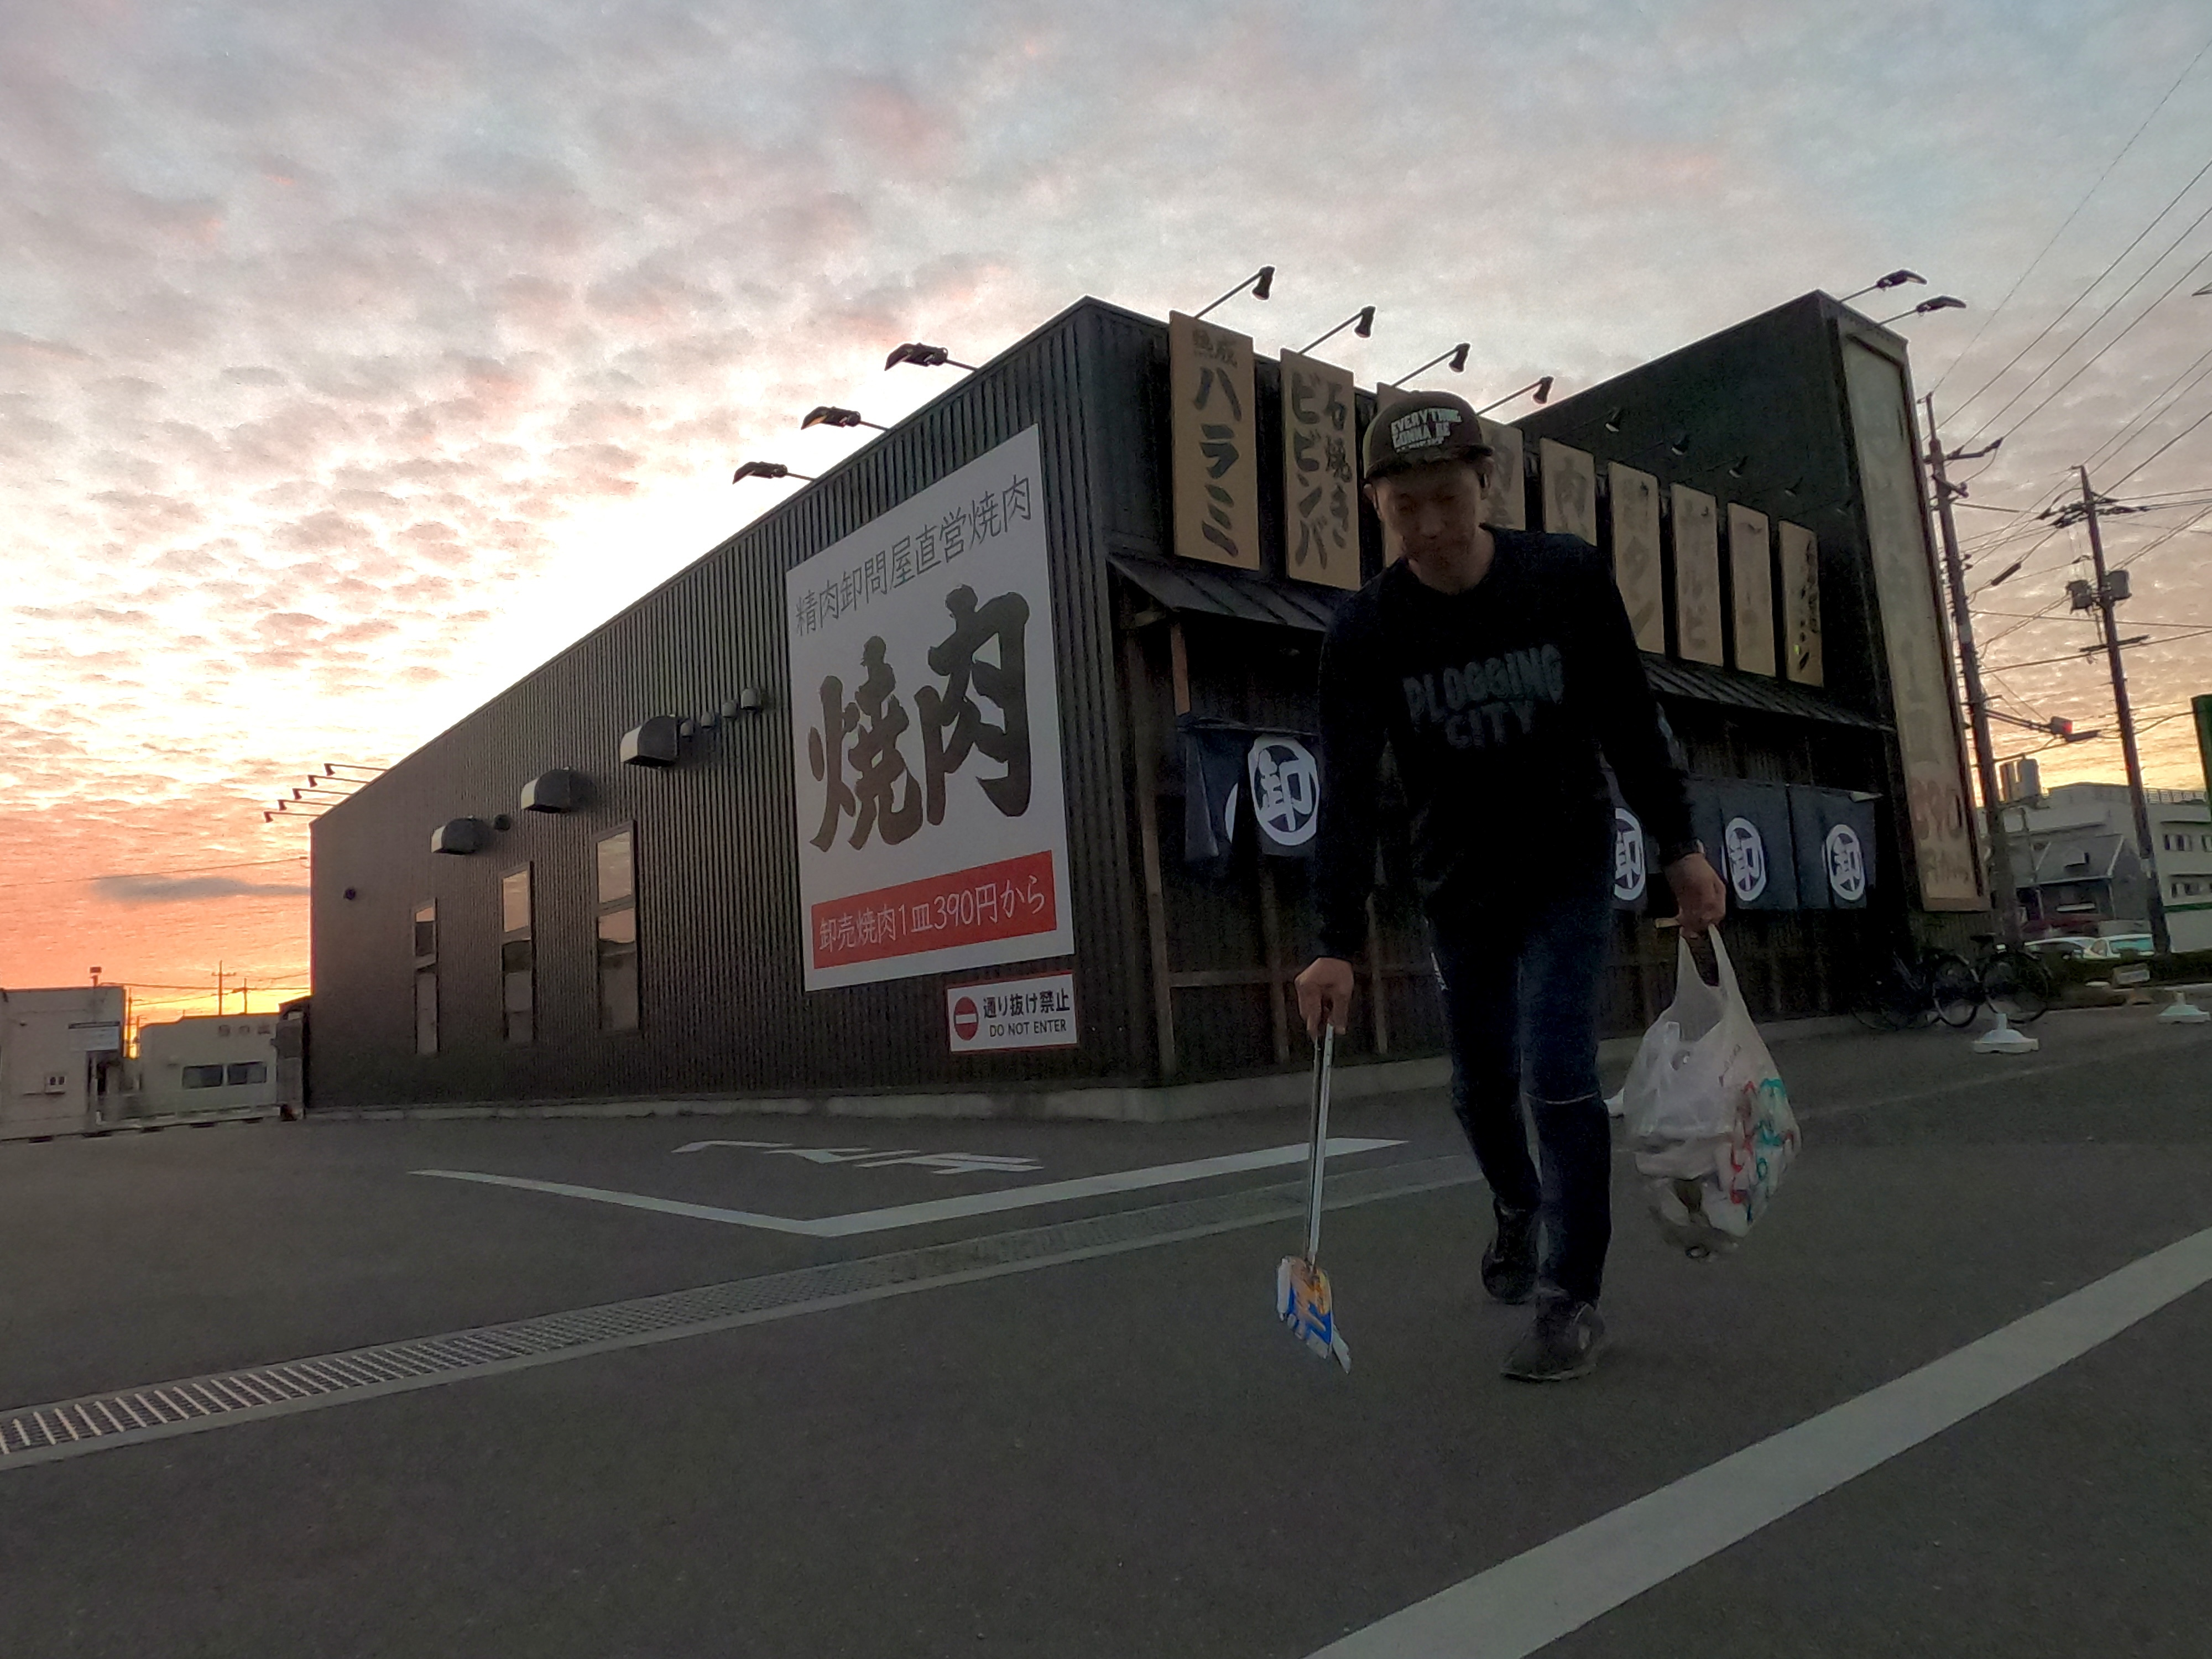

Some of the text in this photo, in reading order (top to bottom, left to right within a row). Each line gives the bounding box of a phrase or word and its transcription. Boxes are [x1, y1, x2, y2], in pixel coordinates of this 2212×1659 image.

[1193, 367, 1242, 559] ハラミ
[1292, 371, 1328, 570] ビビンバ
[795, 474, 1032, 637] 精肉卸問屋直営焼肉
[808, 583, 1031, 853] 焼肉
[1443, 700, 1535, 749] CITY
[818, 874, 1046, 953] 卸売焼肉1皿390円から
[983, 988, 1070, 1019] 通り抜け禁止
[990, 1019, 1067, 1037] DO NOT ENTER
